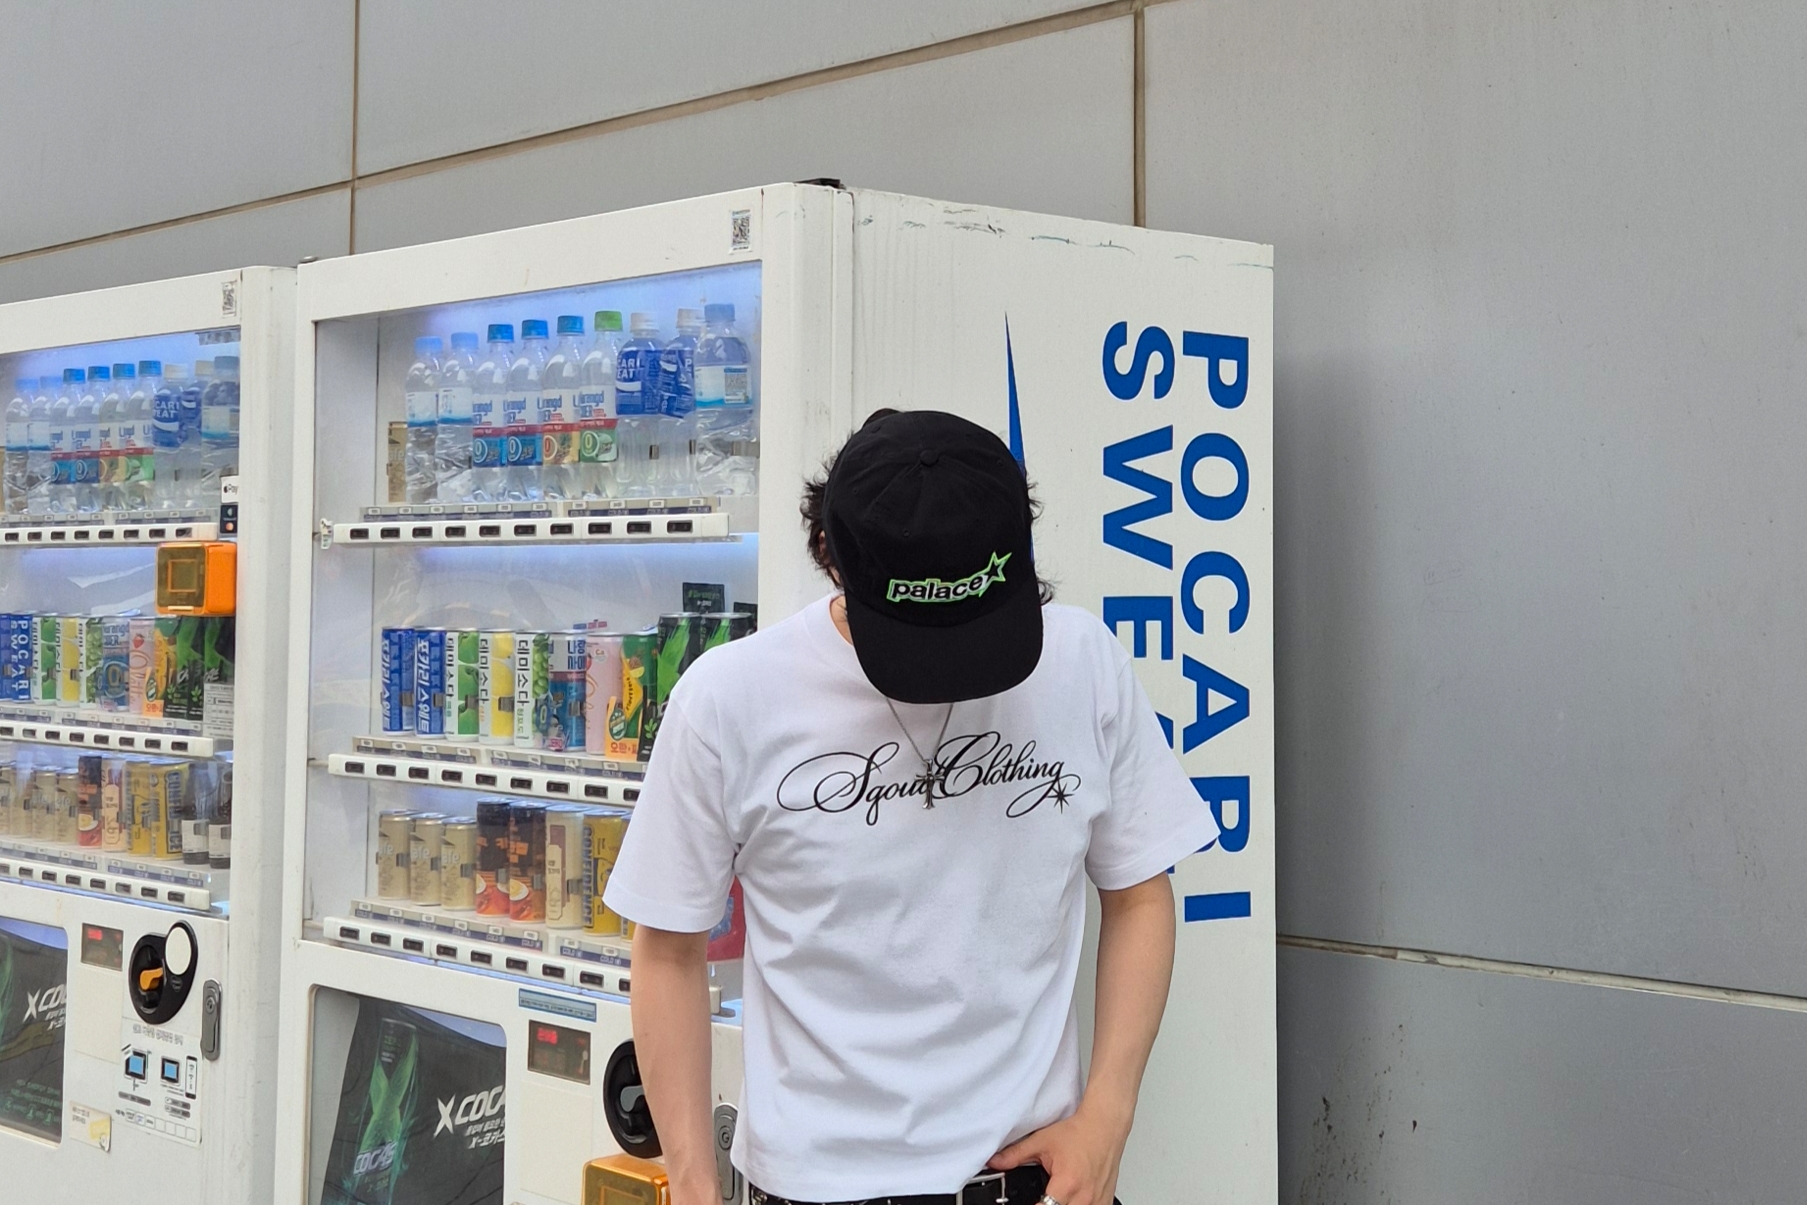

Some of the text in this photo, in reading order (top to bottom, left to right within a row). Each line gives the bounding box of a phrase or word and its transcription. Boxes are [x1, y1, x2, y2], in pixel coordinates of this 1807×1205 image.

[889, 574, 985, 601] palace
[1180, 330, 1252, 922] POCARI
[10, 620, 19, 692] SWEAT
[17, 619, 30, 701] POCARI
[516, 639, 531, 704] 데미소다
[933, 731, 1081, 818] Clothing
